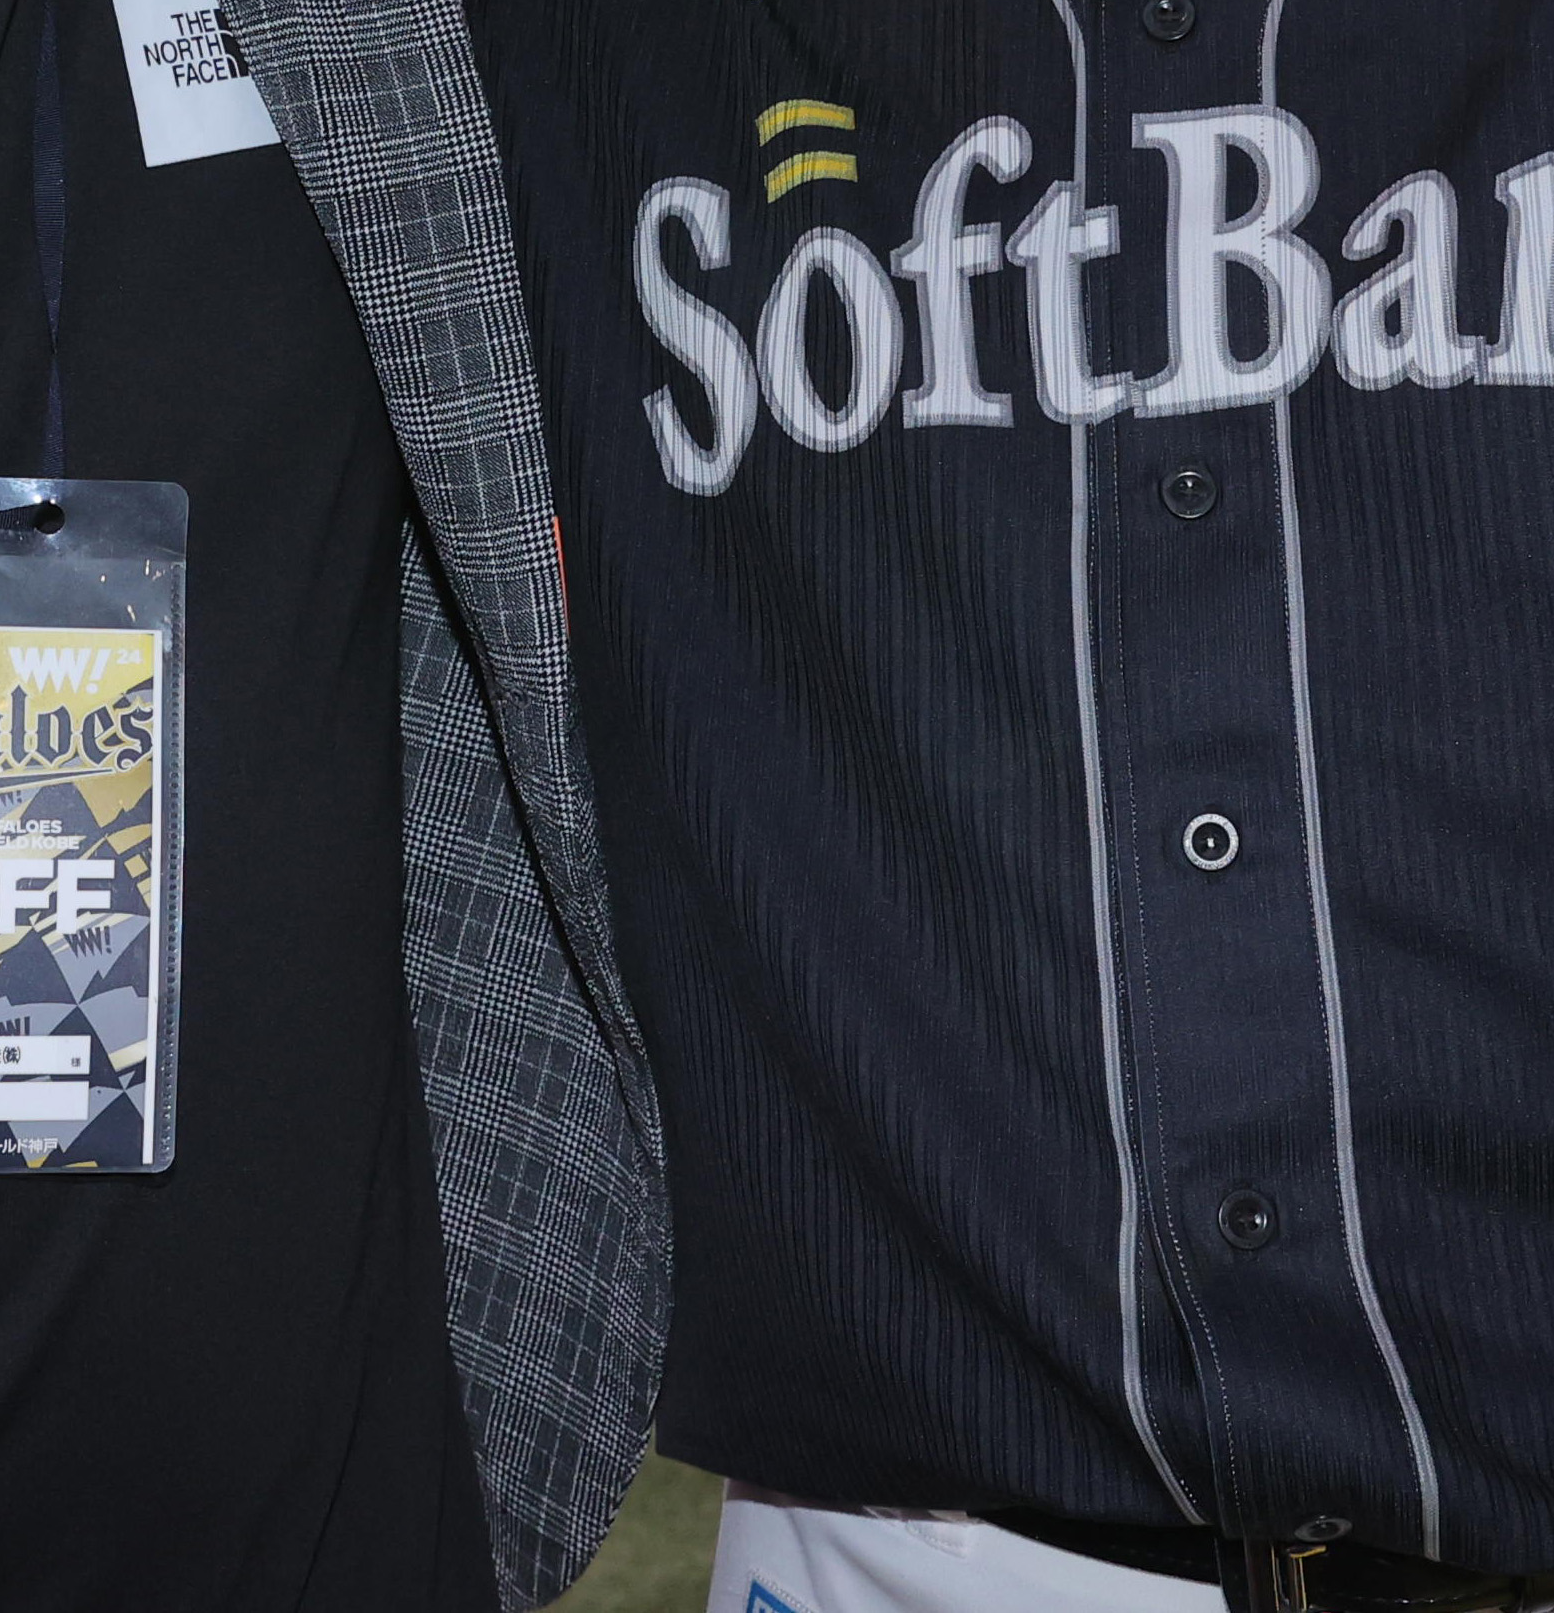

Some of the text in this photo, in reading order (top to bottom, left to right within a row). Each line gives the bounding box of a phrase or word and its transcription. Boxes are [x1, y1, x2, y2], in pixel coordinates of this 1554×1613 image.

[171, 9, 215, 36] THE
[143, 33, 223, 67] NORTH
[172, 57, 229, 88] FACE
[116, 648, 144, 665] 24
[28, 835, 81, 850] KOBE
